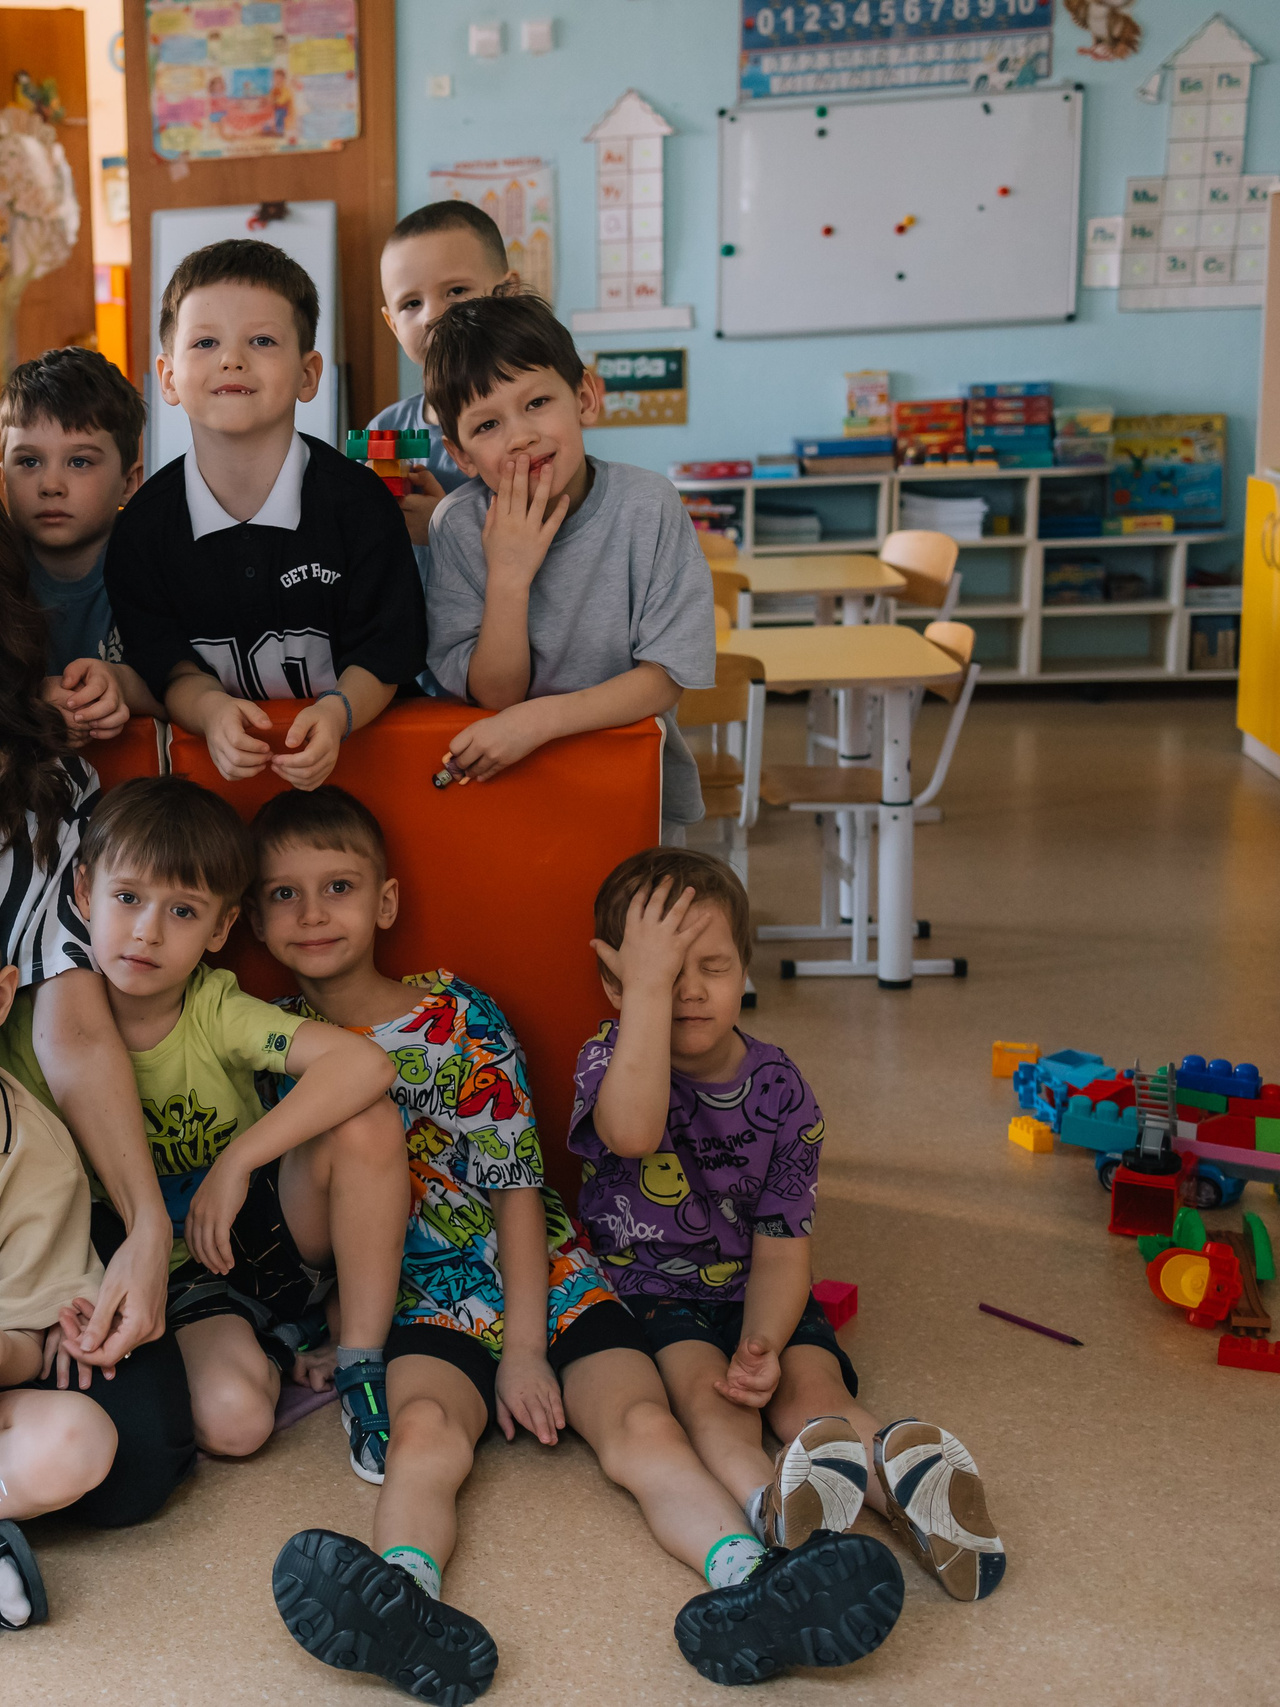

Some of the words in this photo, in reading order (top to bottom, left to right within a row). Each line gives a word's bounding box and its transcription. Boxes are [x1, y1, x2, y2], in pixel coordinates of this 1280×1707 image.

[803, 5, 821, 32] 2
[829, 3, 846, 30] 3
[852, 2, 870, 28] 4
[878, 0, 896, 26] 5
[280, 565, 308, 588] GET
